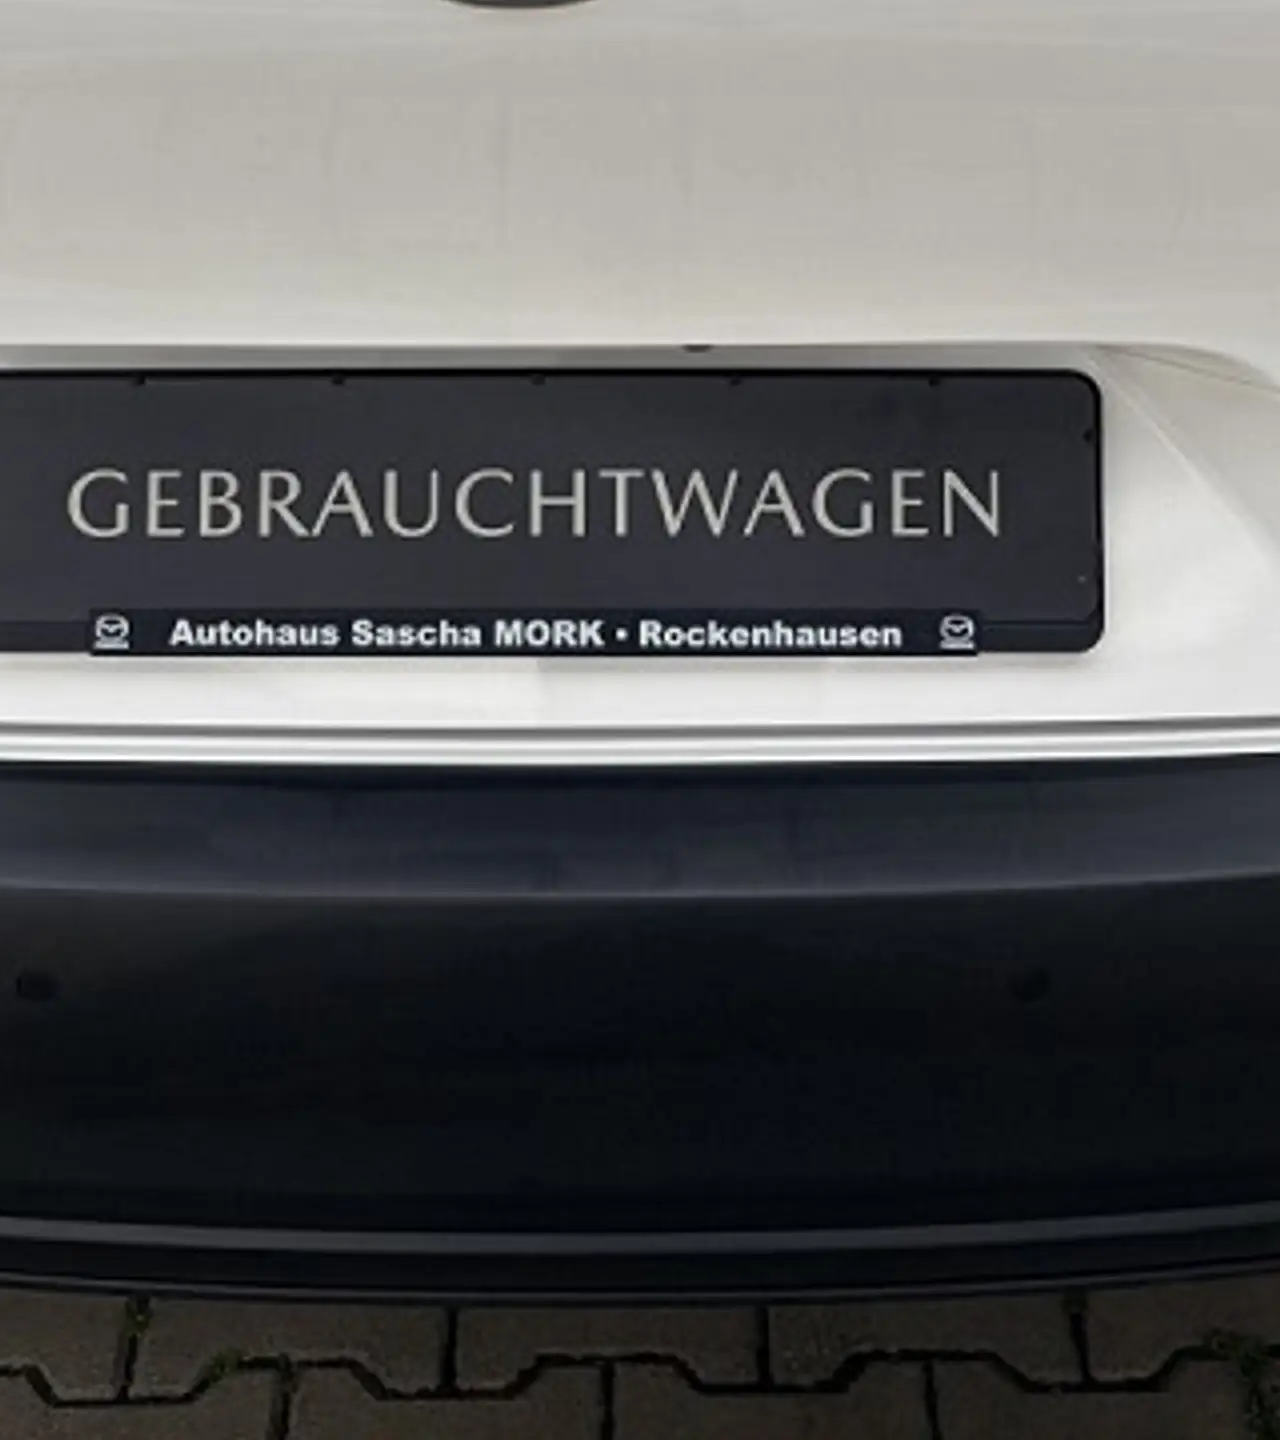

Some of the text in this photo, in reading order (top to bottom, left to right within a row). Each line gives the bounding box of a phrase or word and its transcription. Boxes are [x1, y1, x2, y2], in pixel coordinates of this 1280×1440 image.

[68, 469, 999, 538] GEBRAUCHTWAGEN
[169, 619, 902, 647] Autohaus Sascha MORK Rockenhausen
